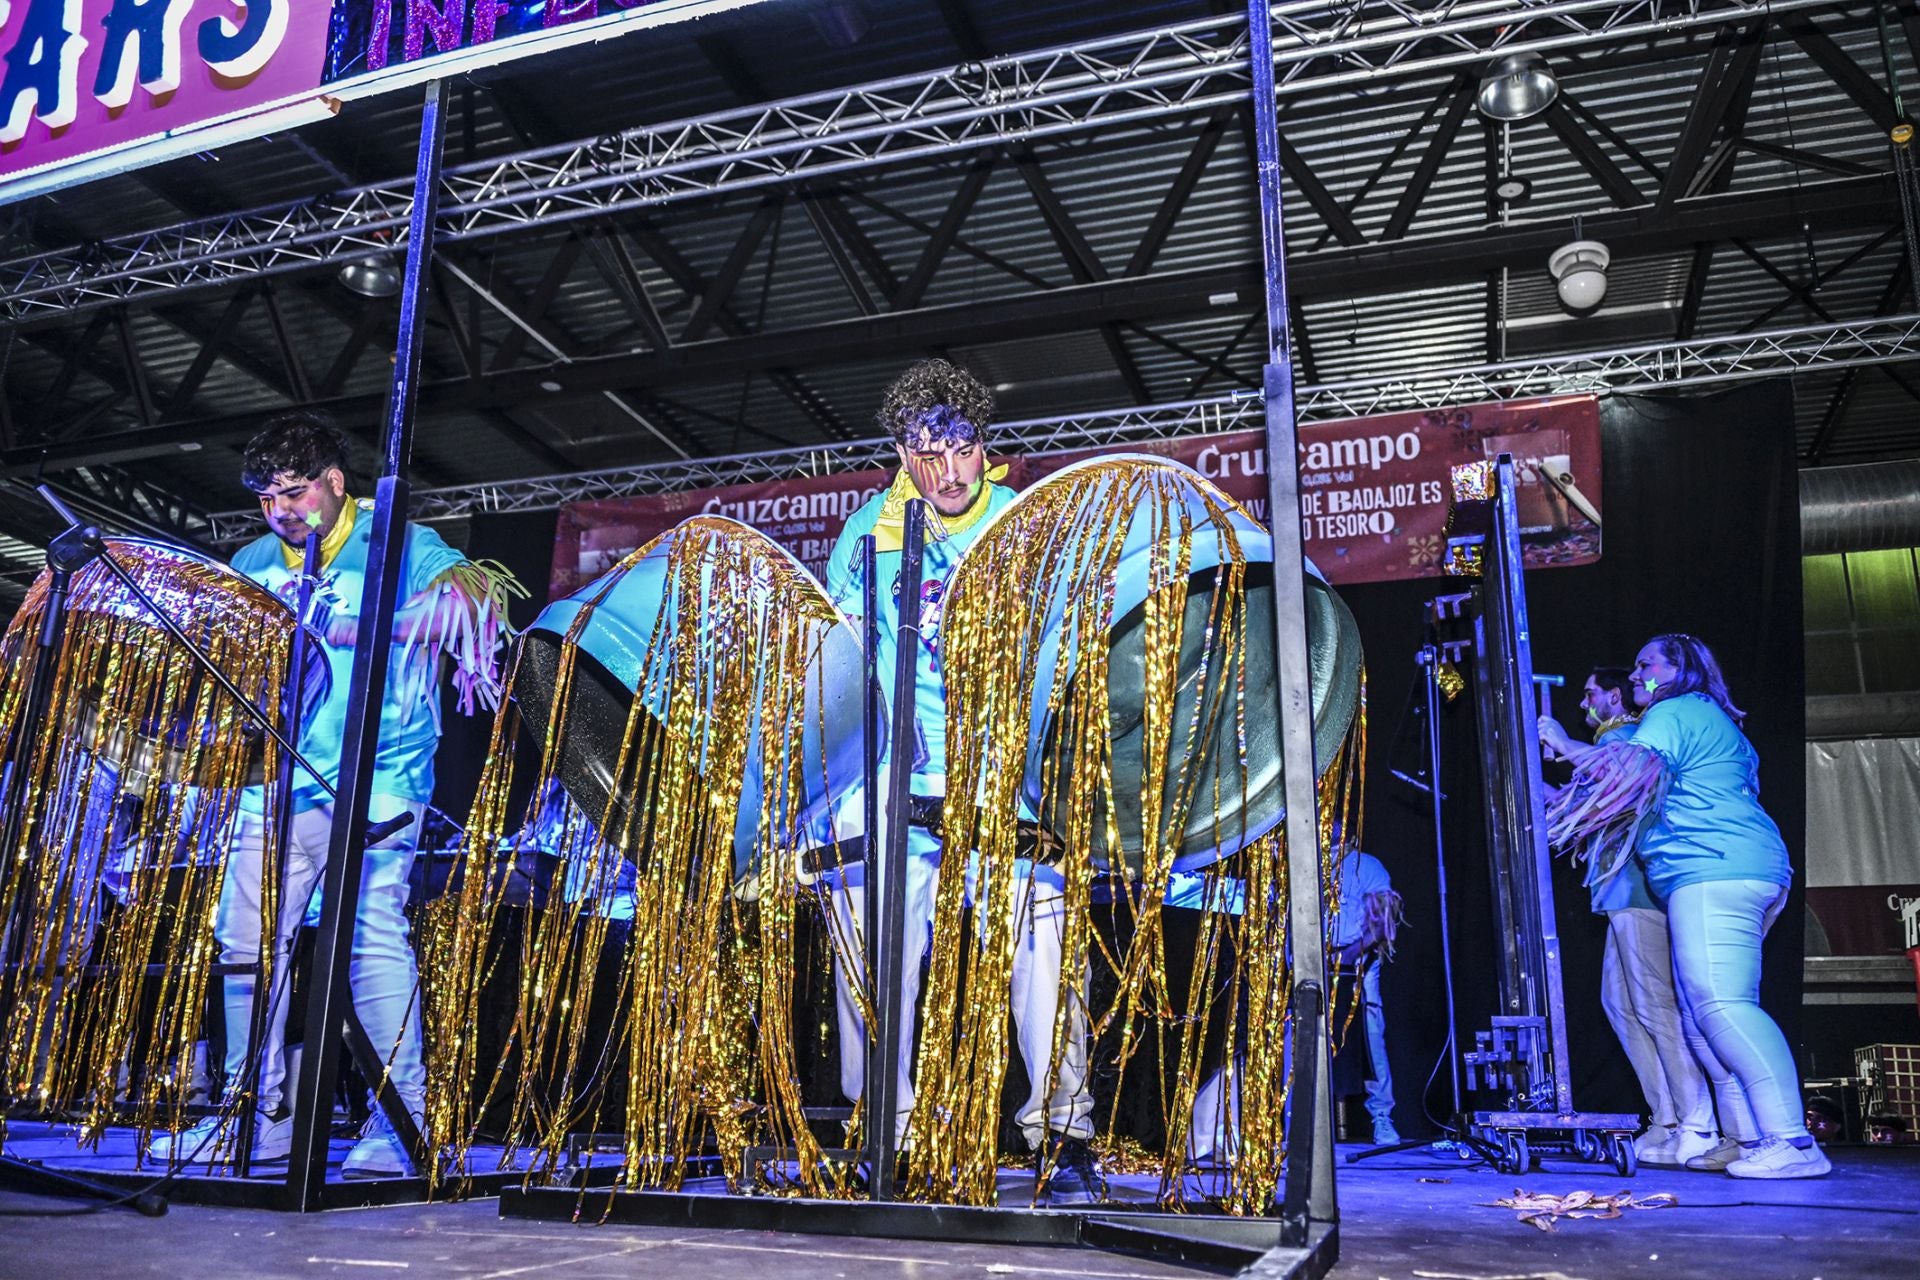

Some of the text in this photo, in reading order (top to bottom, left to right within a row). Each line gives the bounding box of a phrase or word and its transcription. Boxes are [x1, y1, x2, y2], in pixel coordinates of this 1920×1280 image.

[1196, 431, 1421, 479] Cruampo
[1302, 491, 1323, 517] DE
[1328, 483, 1416, 514] BADAJOZ
[1421, 481, 1442, 504] ES
[1316, 510, 1396, 540] TESORO
